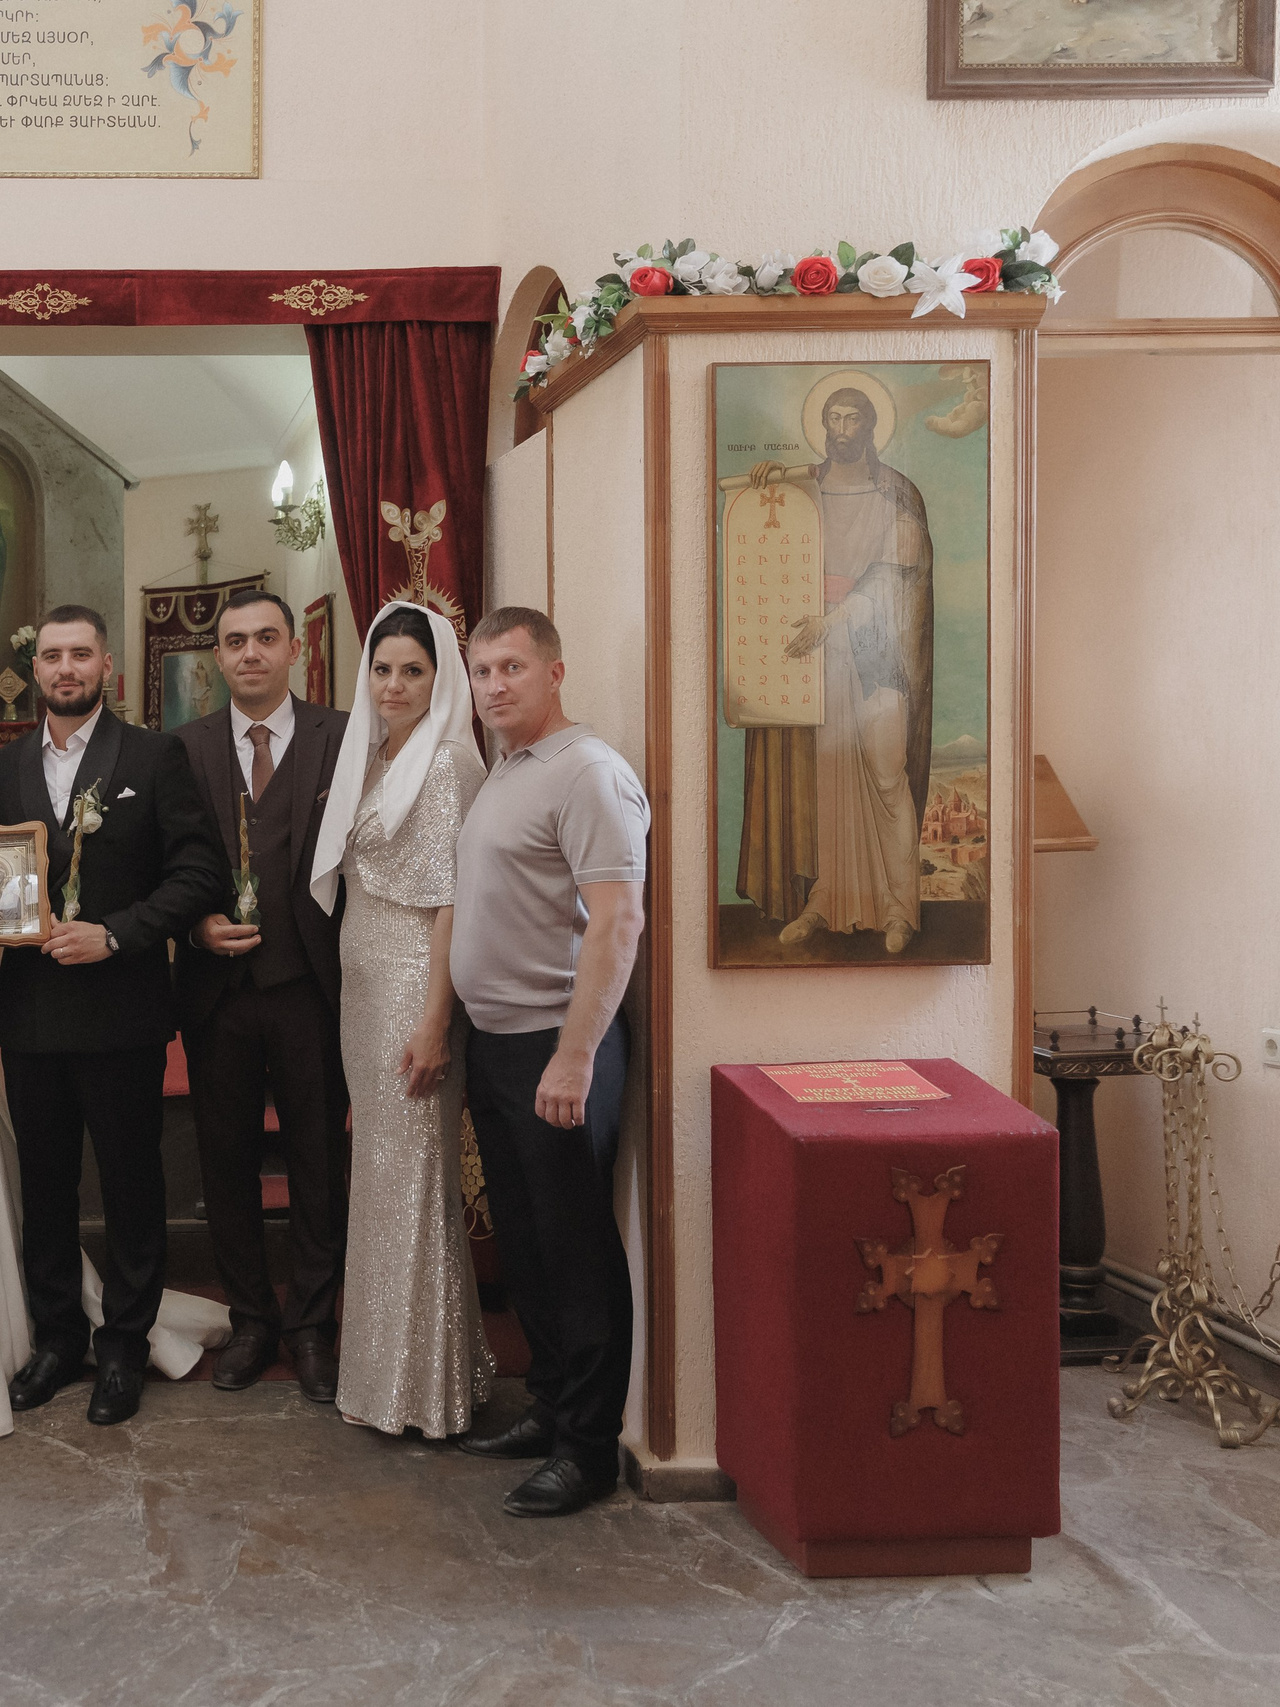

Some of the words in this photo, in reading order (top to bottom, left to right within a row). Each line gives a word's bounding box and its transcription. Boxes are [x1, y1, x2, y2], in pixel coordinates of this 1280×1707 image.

[0, 30, 32, 44] ՄԵԶ
[36, 30, 94, 46] ԱՅՍՕՐ,
[1, 51, 36, 68] ՄԵՐ,
[6, 94, 58, 108] ՓՐԿԵԱ
[62, 94, 103, 108] ԶՄԵԶ
[107, 94, 116, 108] Ի
[121, 94, 161, 108] ՉԱՐԷ.
[0, 115, 16, 129] ԵՒ
[20, 115, 65, 129] ՓԱՌՔ
[69, 115, 161, 129] ՅԱՒԻՏԵԱՆՍ.
